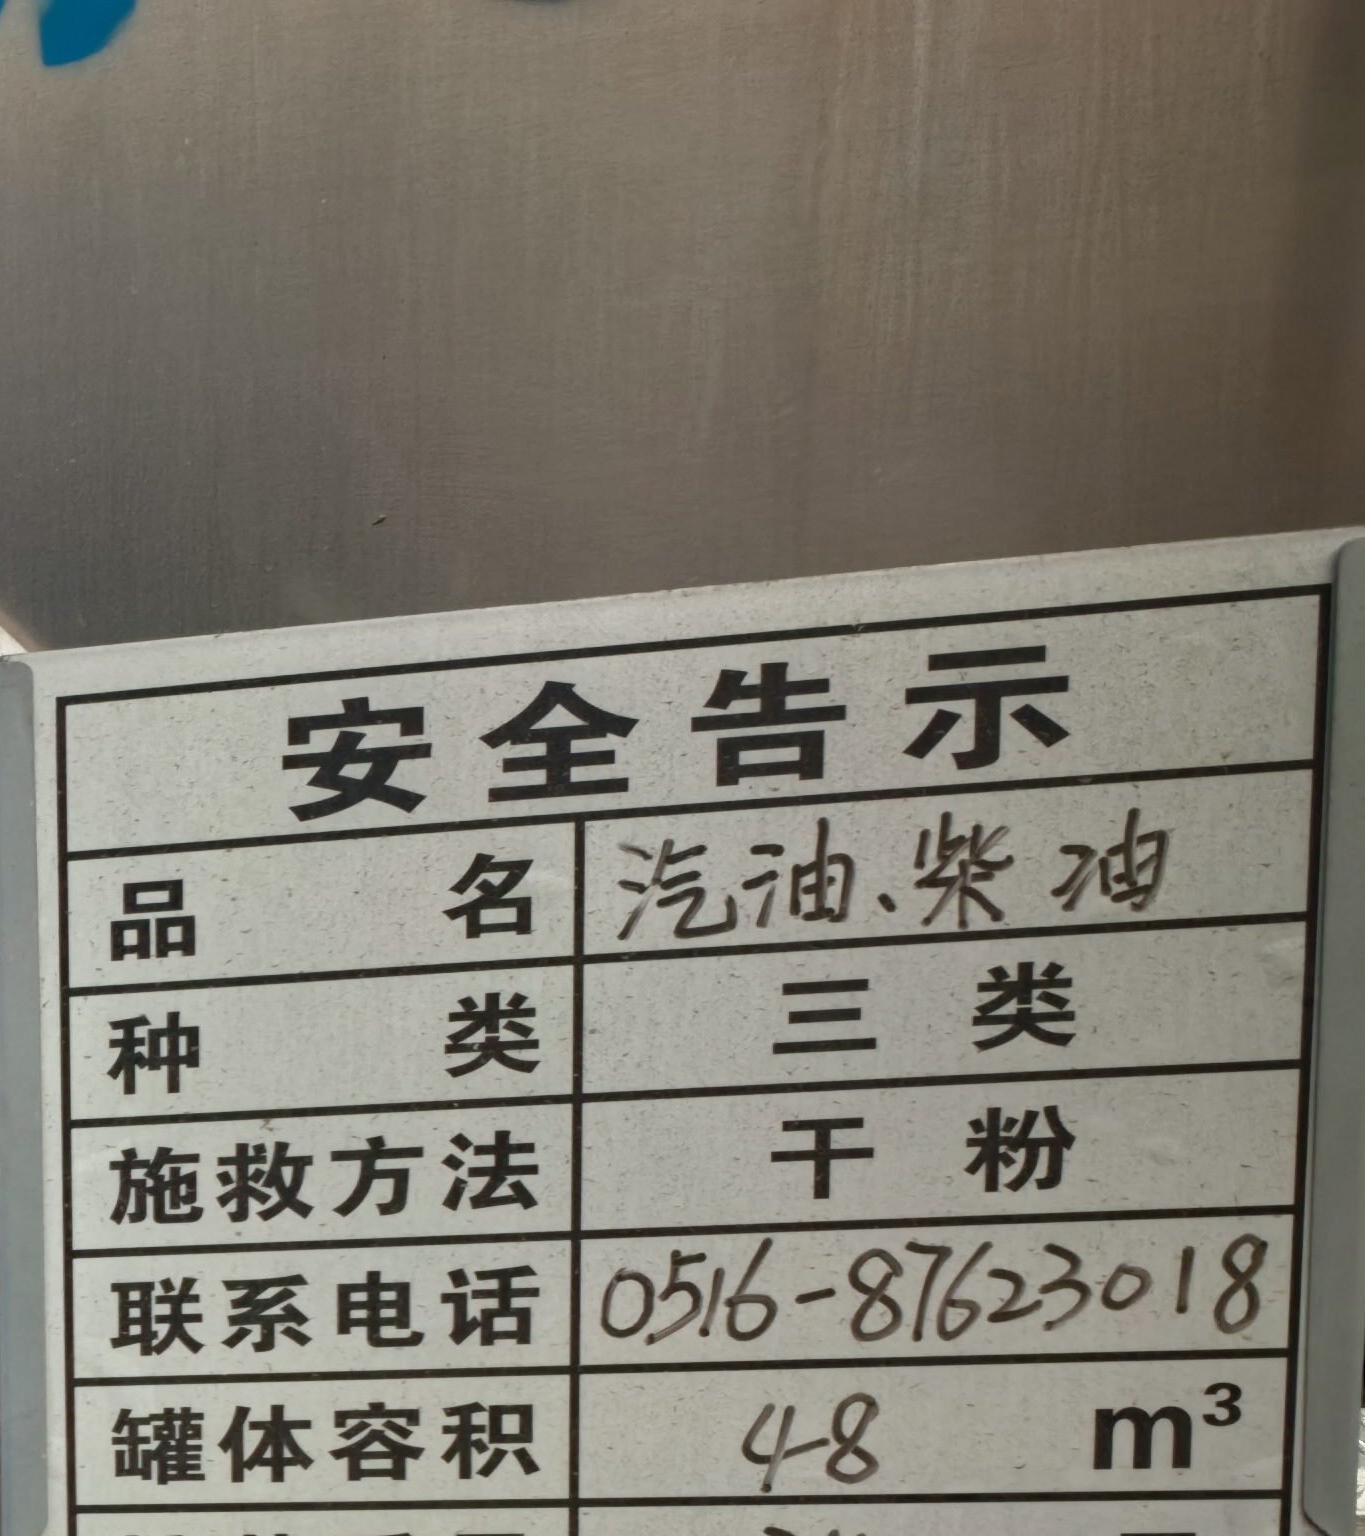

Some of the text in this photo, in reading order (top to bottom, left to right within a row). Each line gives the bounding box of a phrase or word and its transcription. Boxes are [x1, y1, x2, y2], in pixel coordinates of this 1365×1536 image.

[282, 645, 1071, 820] 安全告示
[109, 854, 536, 961] 品名
[109, 992, 540, 1094] 种类
[773, 960, 1075, 1057] 三类
[110, 1131, 539, 1224] 施救方法
[772, 1106, 1075, 1199] 干粉
[111, 1268, 539, 1355] 联系电话
[600, 1237, 1267, 1343] 0516-87623018
[111, 1404, 538, 1485] 罐体容积
[741, 1392, 879, 1491] 48
